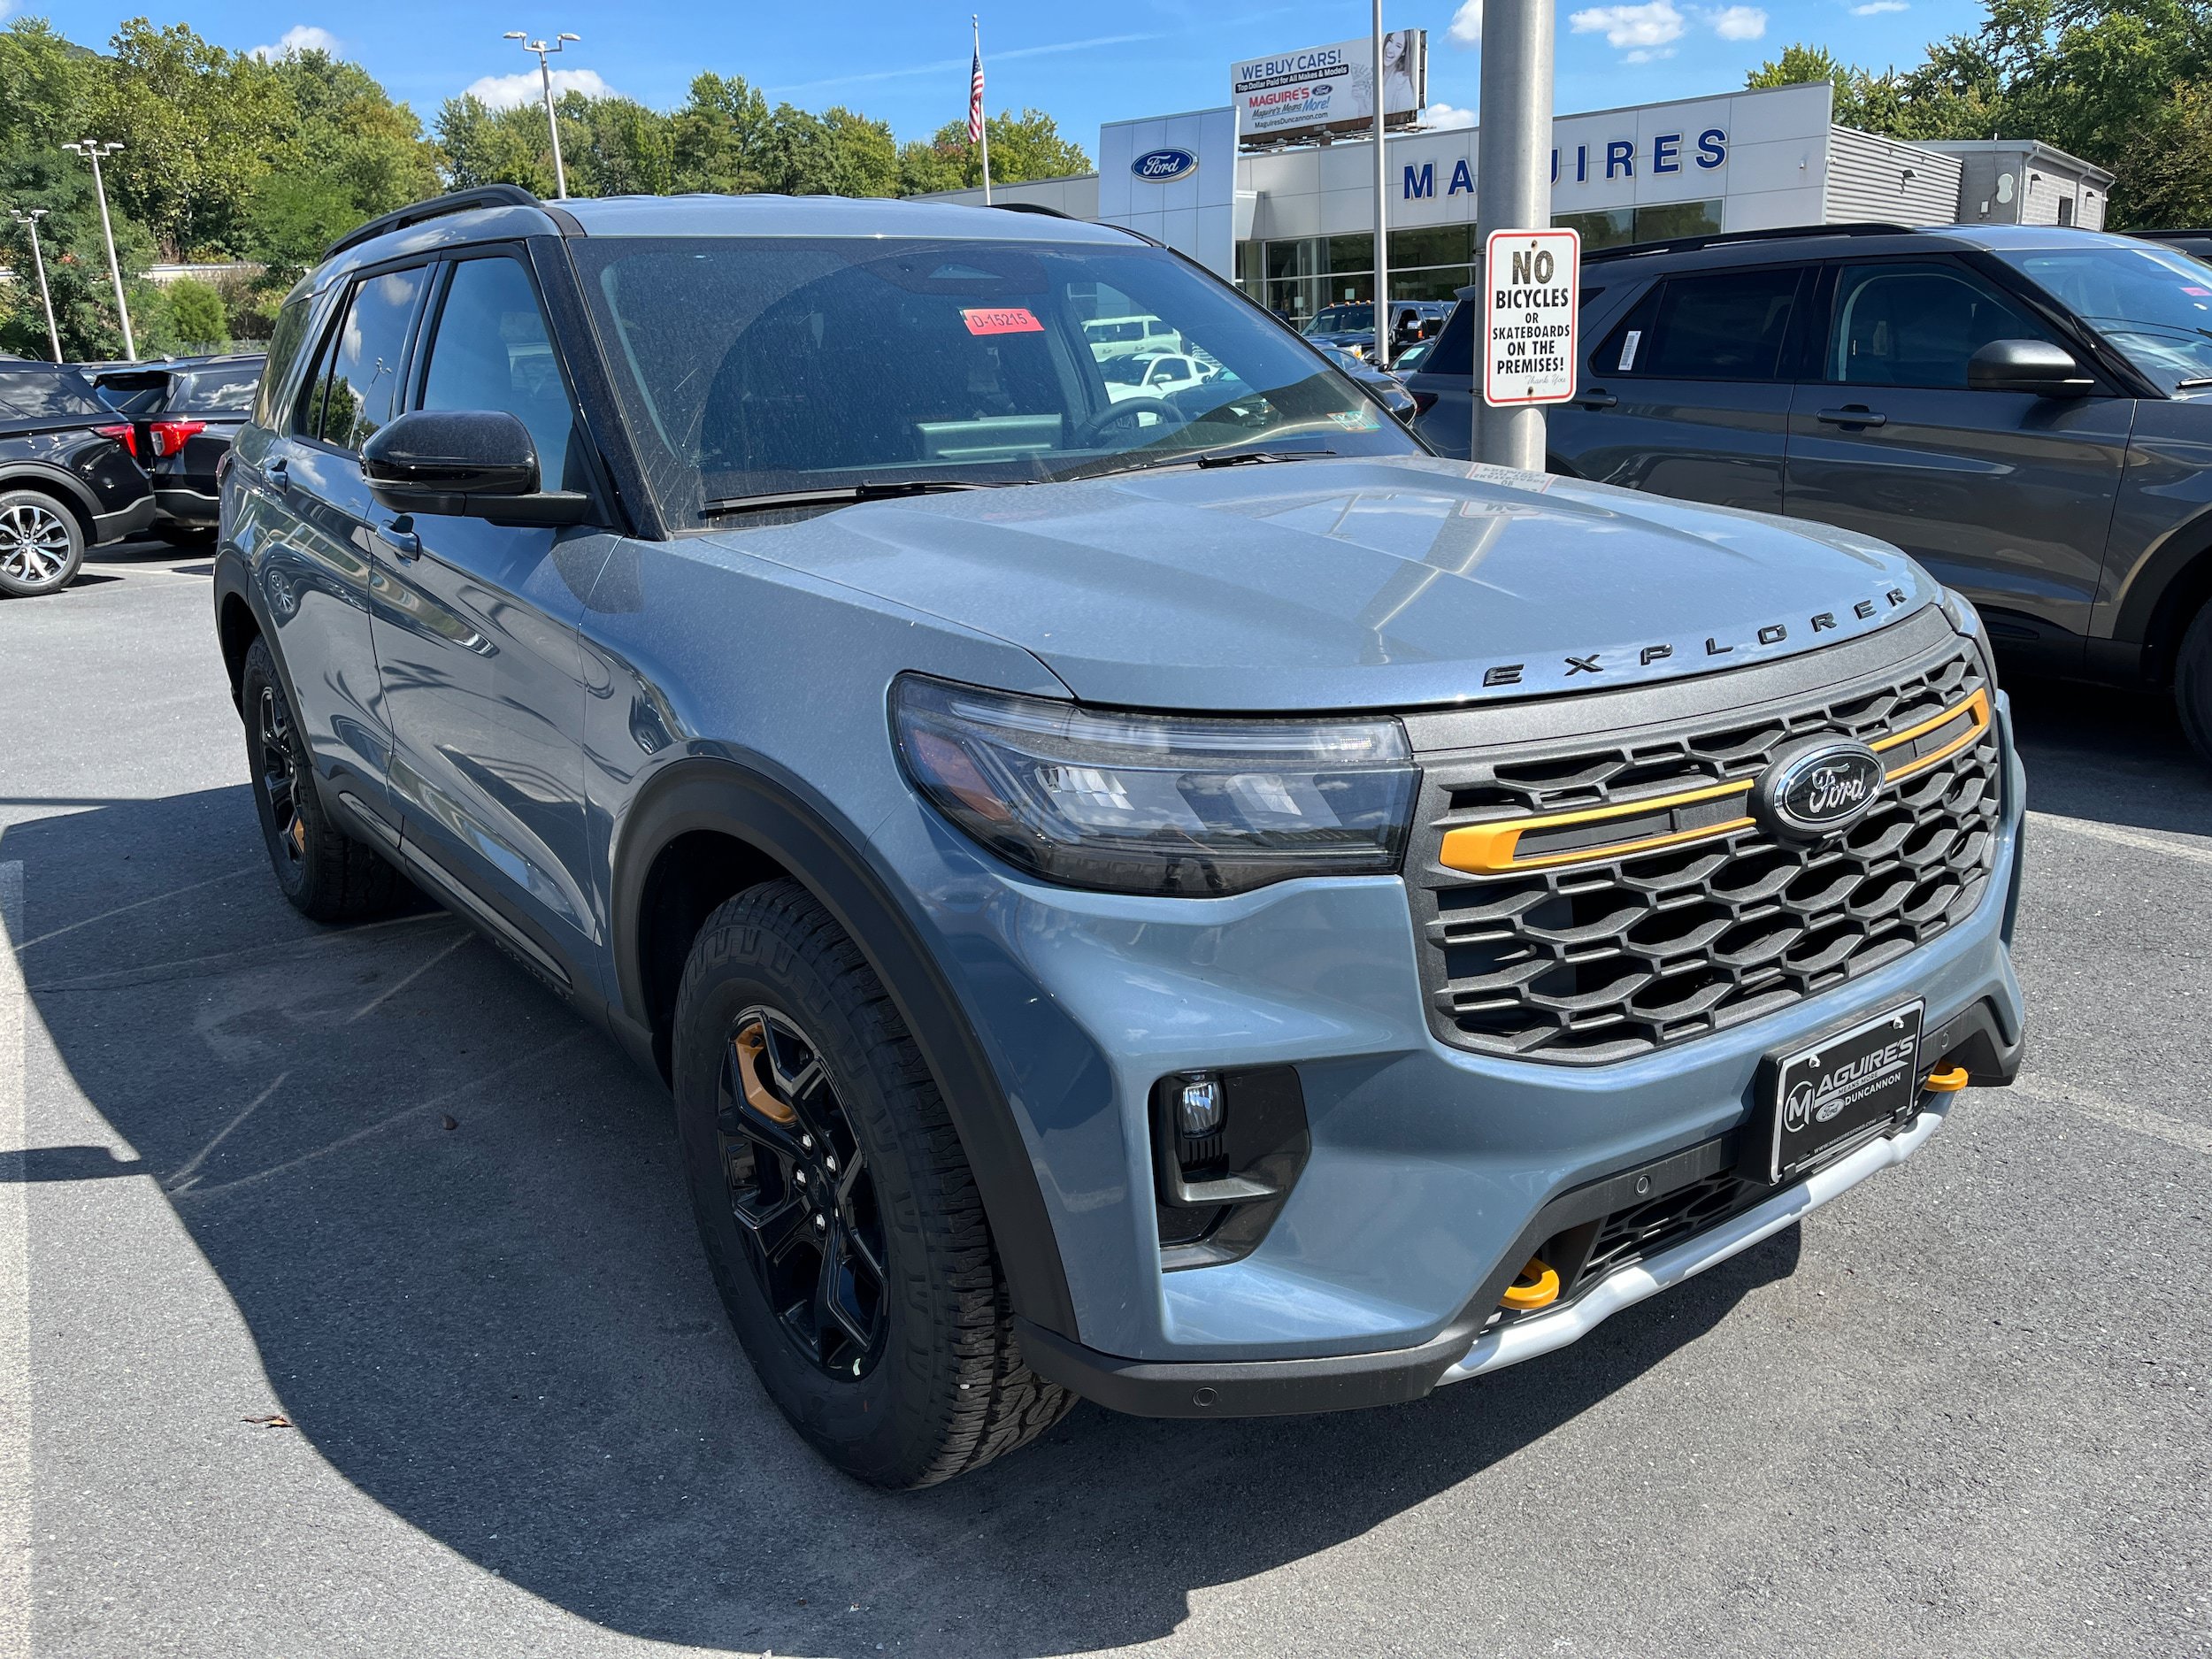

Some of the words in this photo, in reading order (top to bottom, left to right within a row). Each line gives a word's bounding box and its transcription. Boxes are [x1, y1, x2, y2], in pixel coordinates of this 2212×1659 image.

[1241, 64, 1263, 81] WE
[1265, 58, 1294, 76] BUY
[1297, 49, 1341, 70] CARS!
[1237, 84, 1248, 93] Top
[1248, 81, 1266, 90] Dollar
[1265, 78, 1280, 87] Paid
[1297, 71, 1318, 81] Makes
[1324, 65, 1348, 76] Models
[1248, 87, 1310, 108] MAGUIRE'S
[1252, 106, 1281, 119] Maguire's
[1281, 103, 1303, 112] Means
[1302, 96, 1331, 112] More!
[1255, 111, 1328, 128] MaguiresDuncannon.com
[1142, 155, 1180, 175] Ford
[1402, 127, 1728, 200] MAIRES
[1512, 250, 1555, 285] NO
[1495, 288, 1570, 310] BICYCLES
[972, 312, 1028, 327] D-15215
[1525, 312, 1540, 324] OR
[1493, 324, 1571, 341] SKATEBOARDS
[1507, 342, 1525, 357] ON
[1532, 340, 1555, 355] THE
[1496, 357, 1564, 375] PREMISES!
[1525, 375, 1548, 385] Thank
[1551, 373, 1566, 386] You
[1482, 587, 1909, 687] EXPLORER
[1809, 762, 1867, 814] Ford
[1838, 1080, 1860, 1095] MEANS
[1860, 1071, 1878, 1085] MORE
[1845, 1071, 1901, 1106] DUNCANNON
[1822, 1102, 1839, 1119] Ford
